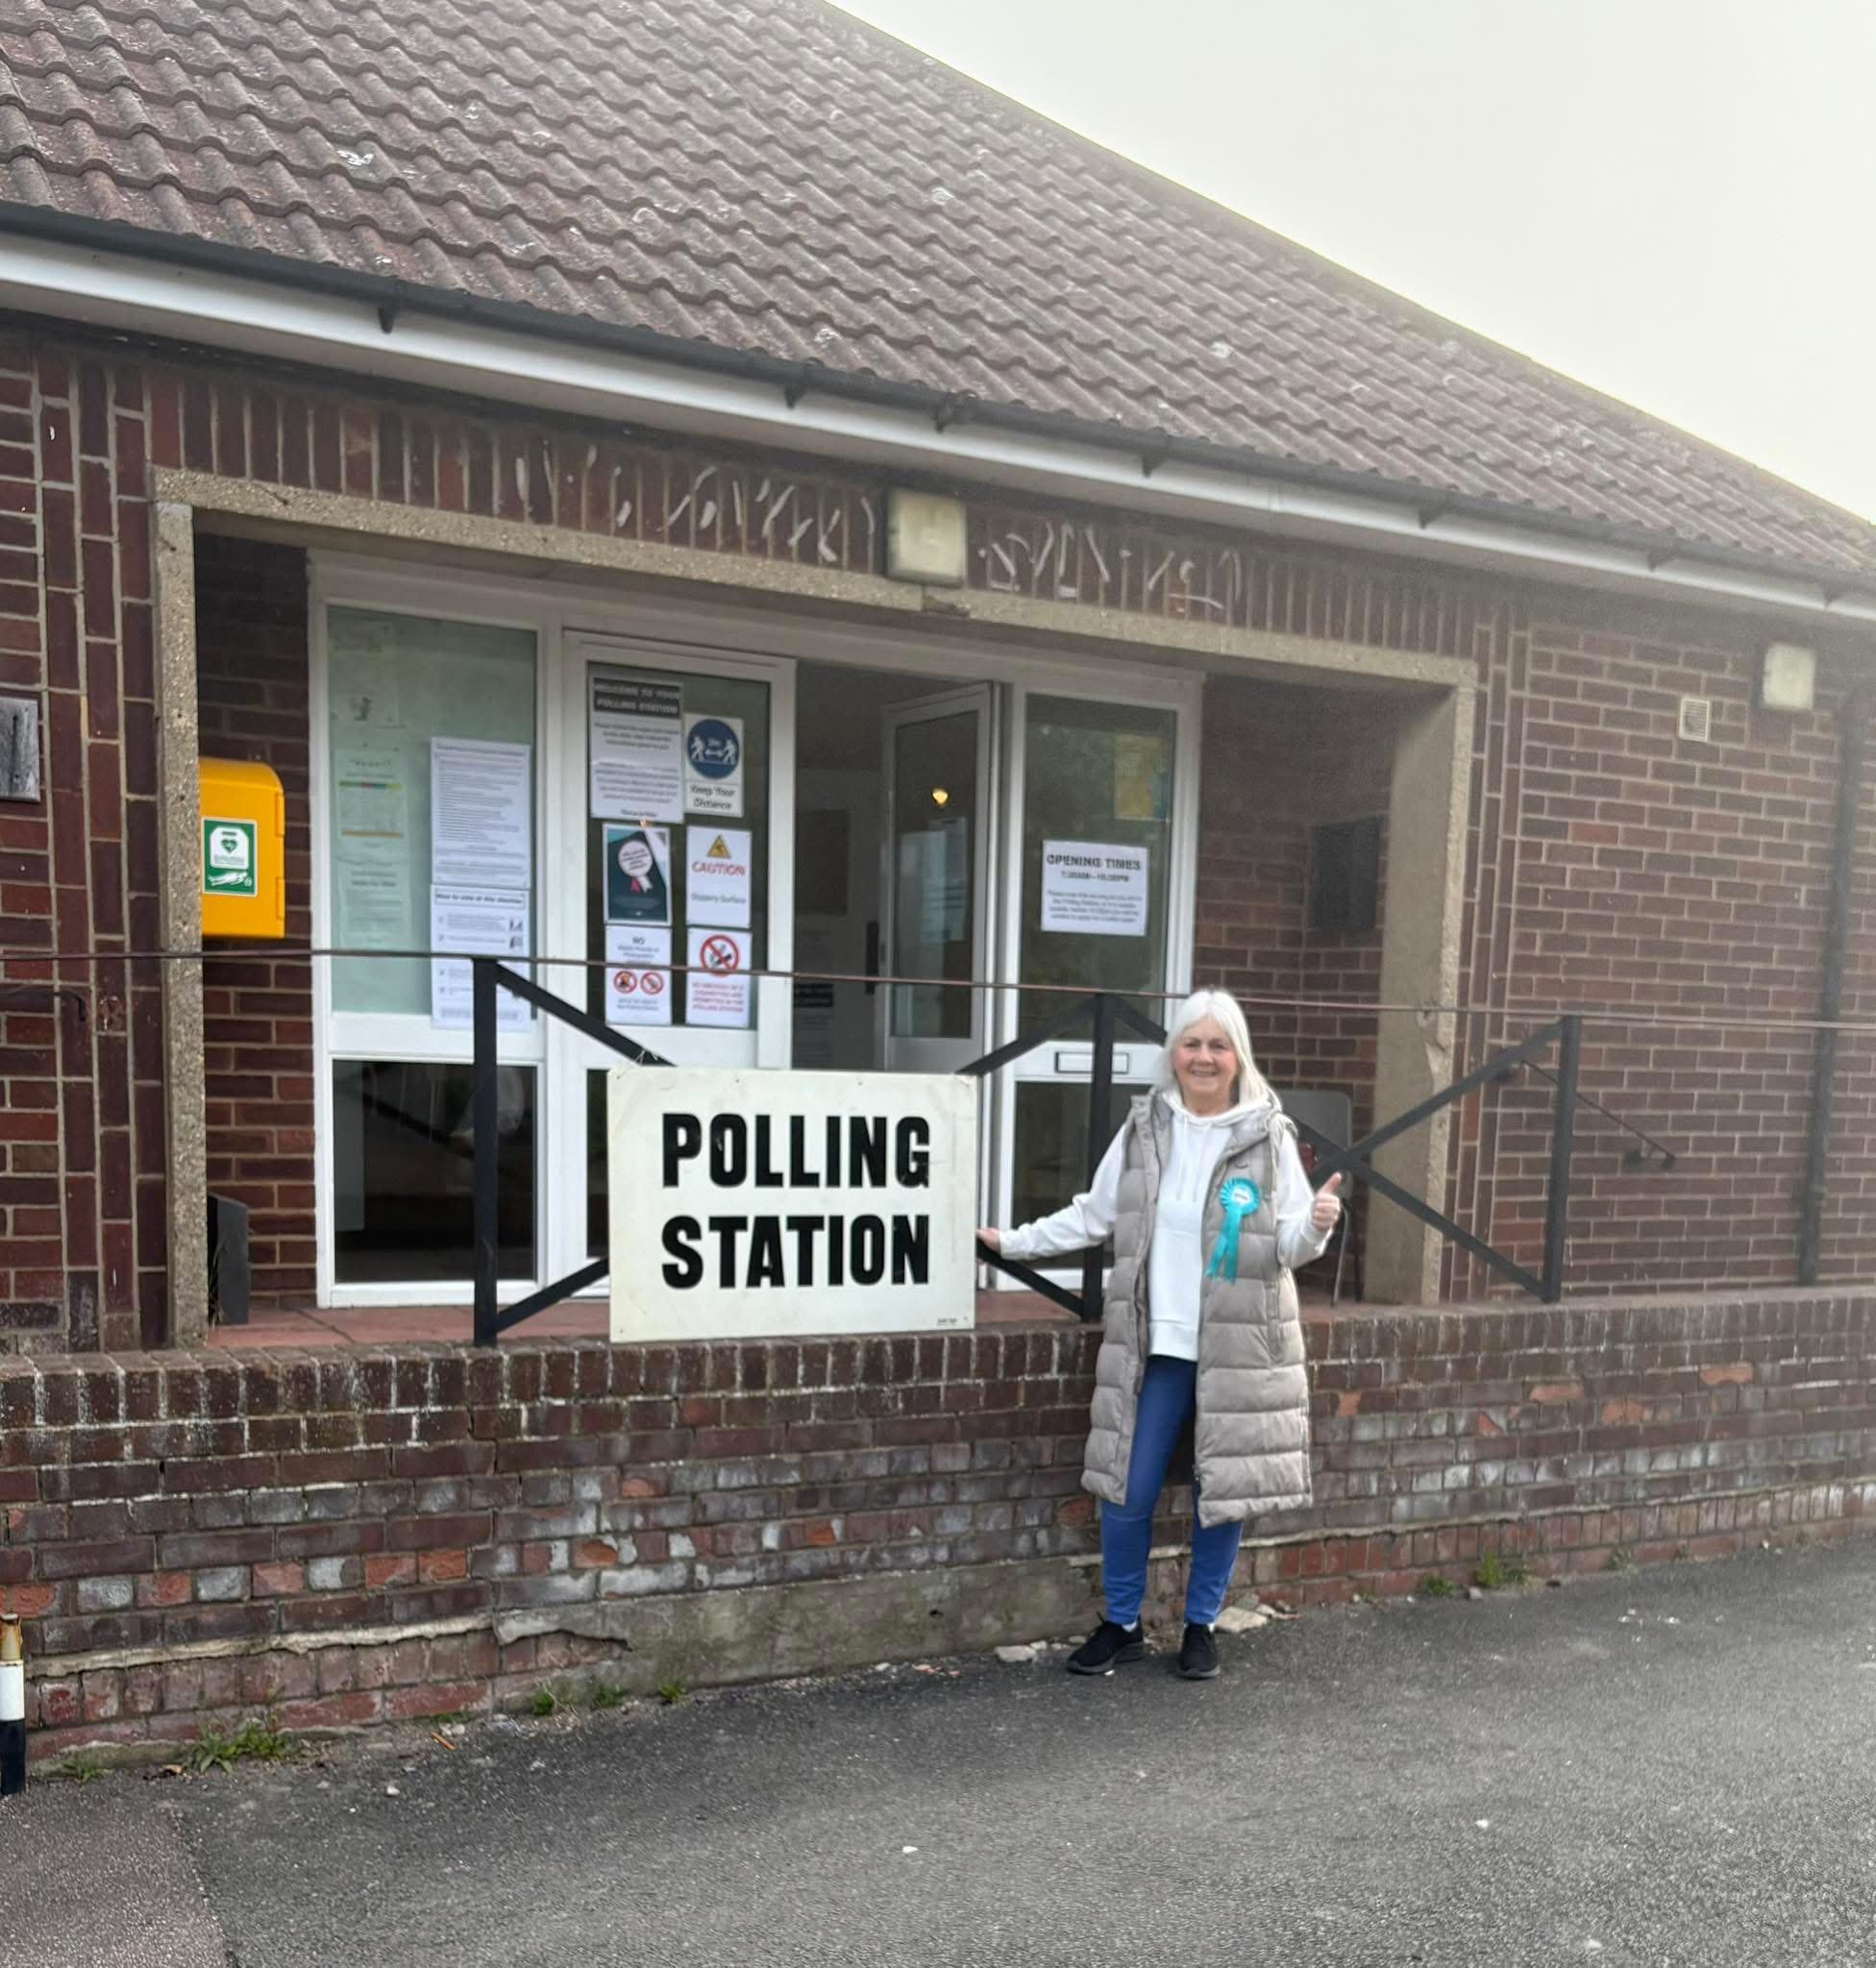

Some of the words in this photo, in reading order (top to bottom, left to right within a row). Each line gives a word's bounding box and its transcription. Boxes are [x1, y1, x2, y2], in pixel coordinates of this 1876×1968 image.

[691, 862, 746, 876] CAUTION
[1046, 854, 1102, 868] OPENING
[1105, 858, 1141, 871] TIMES
[661, 1113, 929, 1189] POLLING
[661, 1214, 929, 1290] STATION
